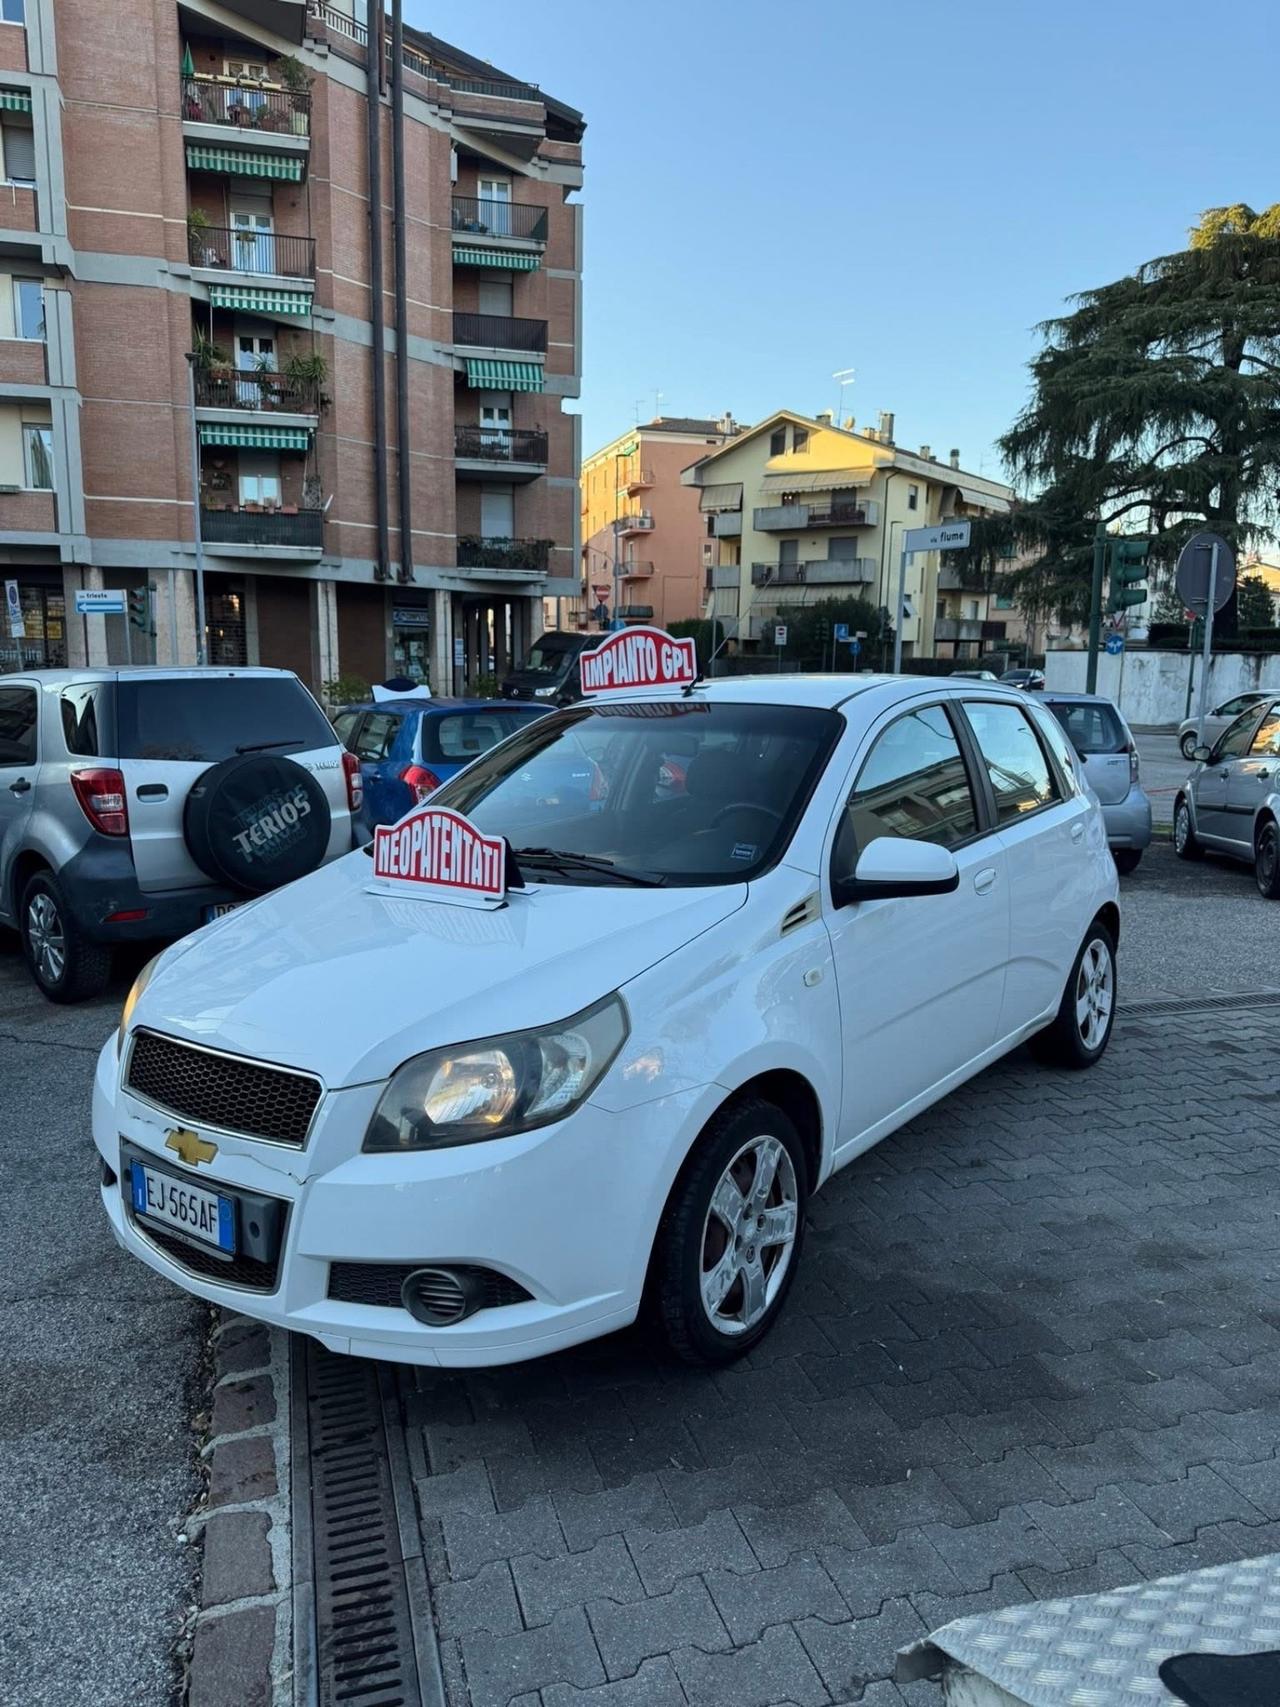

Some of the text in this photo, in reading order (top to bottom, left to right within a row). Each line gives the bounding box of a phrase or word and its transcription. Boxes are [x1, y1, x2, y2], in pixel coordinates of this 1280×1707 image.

[940, 532, 964, 542] fiume
[585, 636, 692, 687] IMPIANTO GPL
[233, 794, 311, 853] TERIOS
[379, 815, 498, 888] NEOPATENTATI
